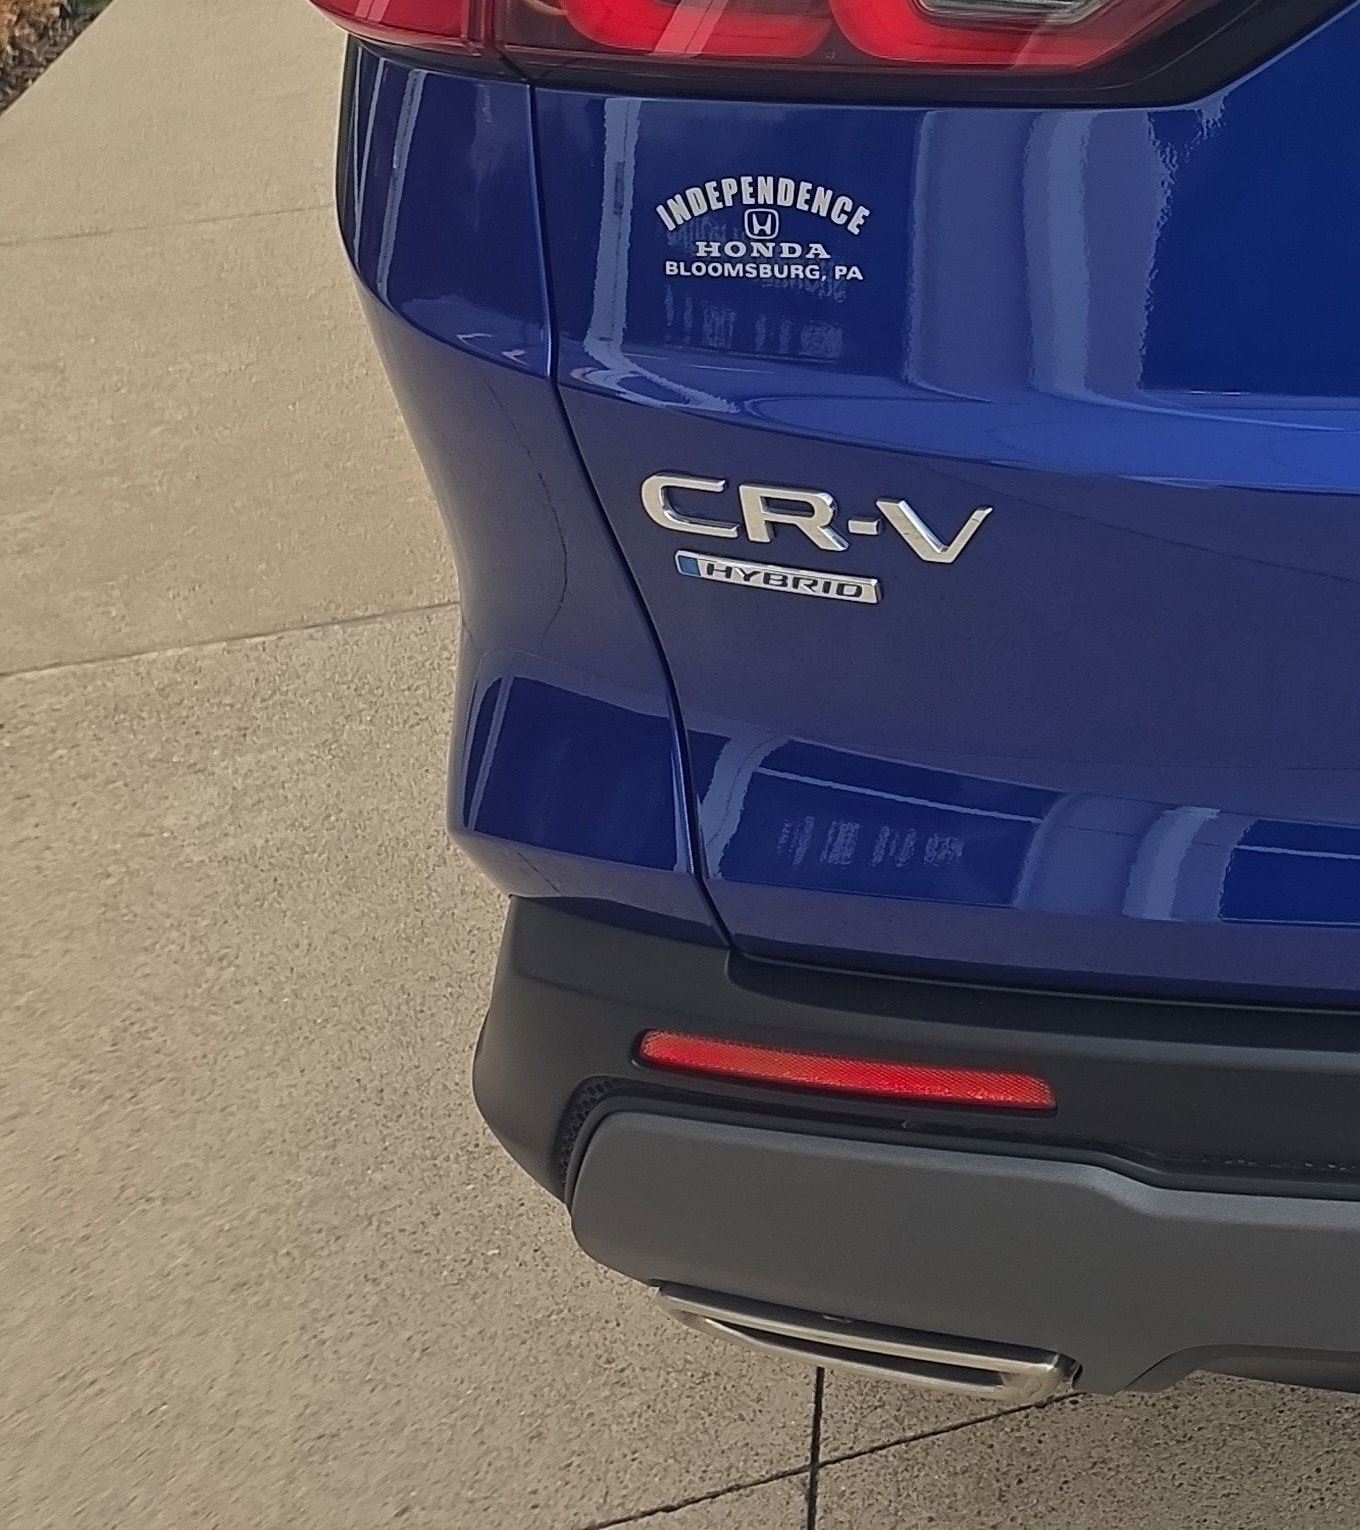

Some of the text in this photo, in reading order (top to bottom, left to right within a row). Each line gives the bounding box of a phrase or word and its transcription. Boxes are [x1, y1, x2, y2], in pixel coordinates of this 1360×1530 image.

[655, 175, 871, 236] INDEPENDENCE
[695, 241, 831, 259] HONDA
[665, 260, 864, 282] BLOOMSBURG, PA
[641, 472, 994, 564] CR-V
[706, 562, 864, 599] HYBRID
